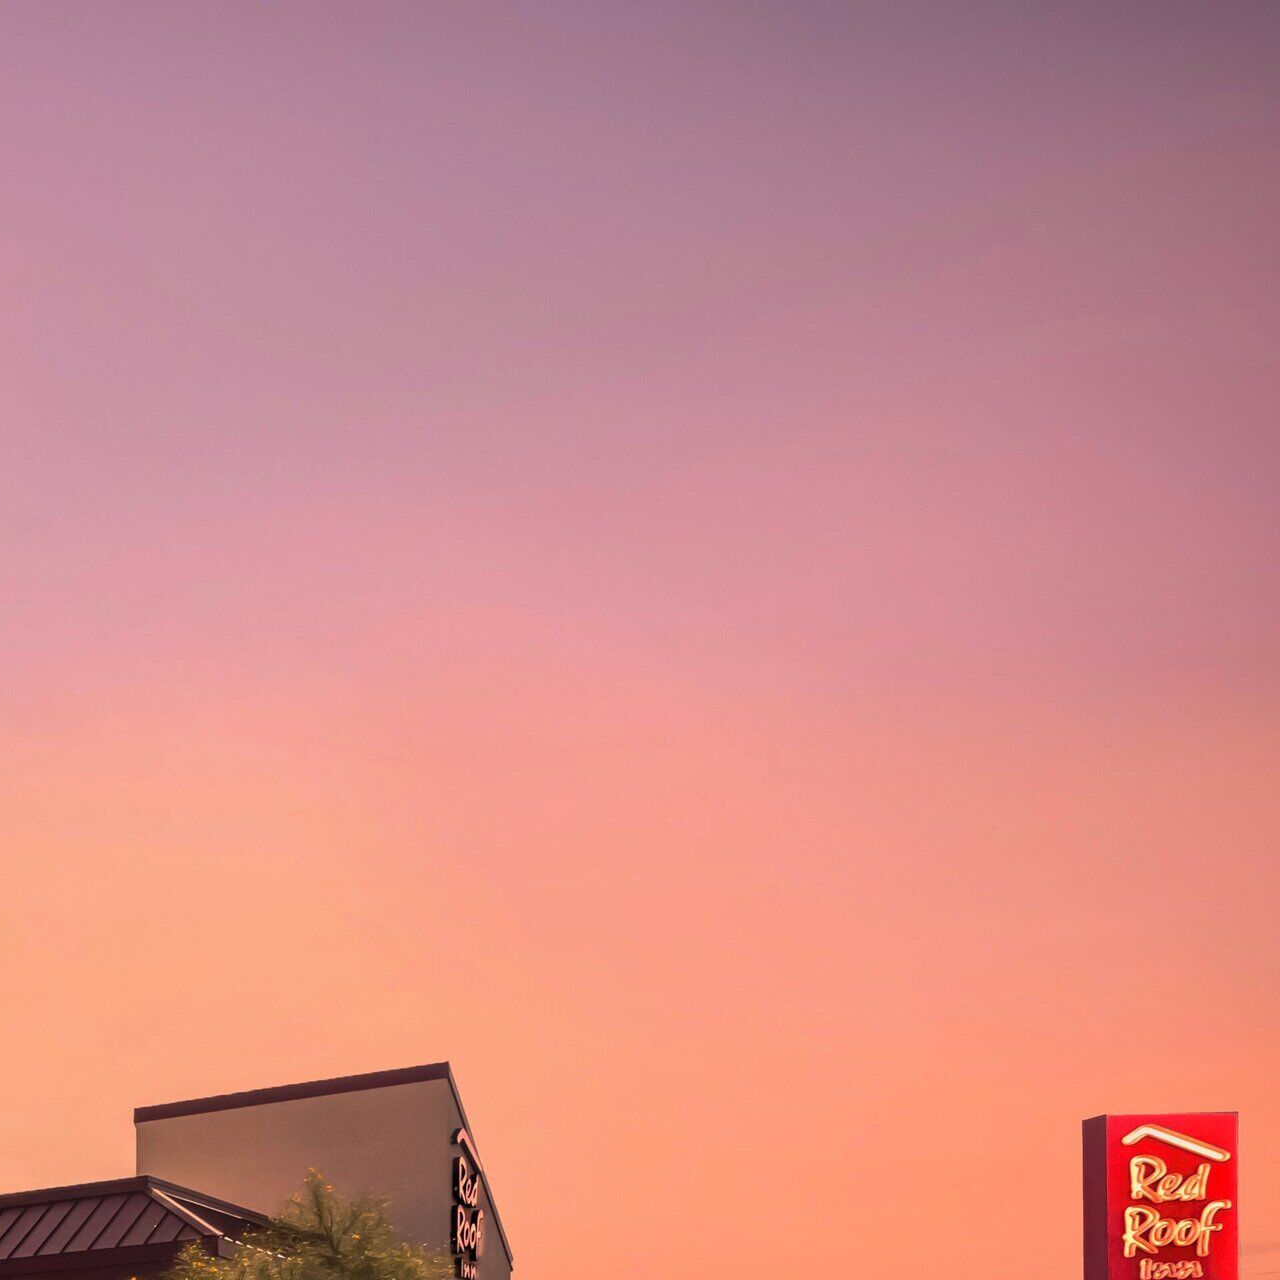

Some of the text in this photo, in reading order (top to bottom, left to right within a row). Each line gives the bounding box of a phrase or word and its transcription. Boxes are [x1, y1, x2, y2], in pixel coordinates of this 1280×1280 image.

[455, 1156, 480, 1207] Red
[1129, 1154, 1211, 1203] Red
[454, 1204, 485, 1261] Roof
[1122, 1199, 1232, 1258] Roof
[457, 1258, 478, 1280] Inn
[1140, 1258, 1203, 1280] Inn
